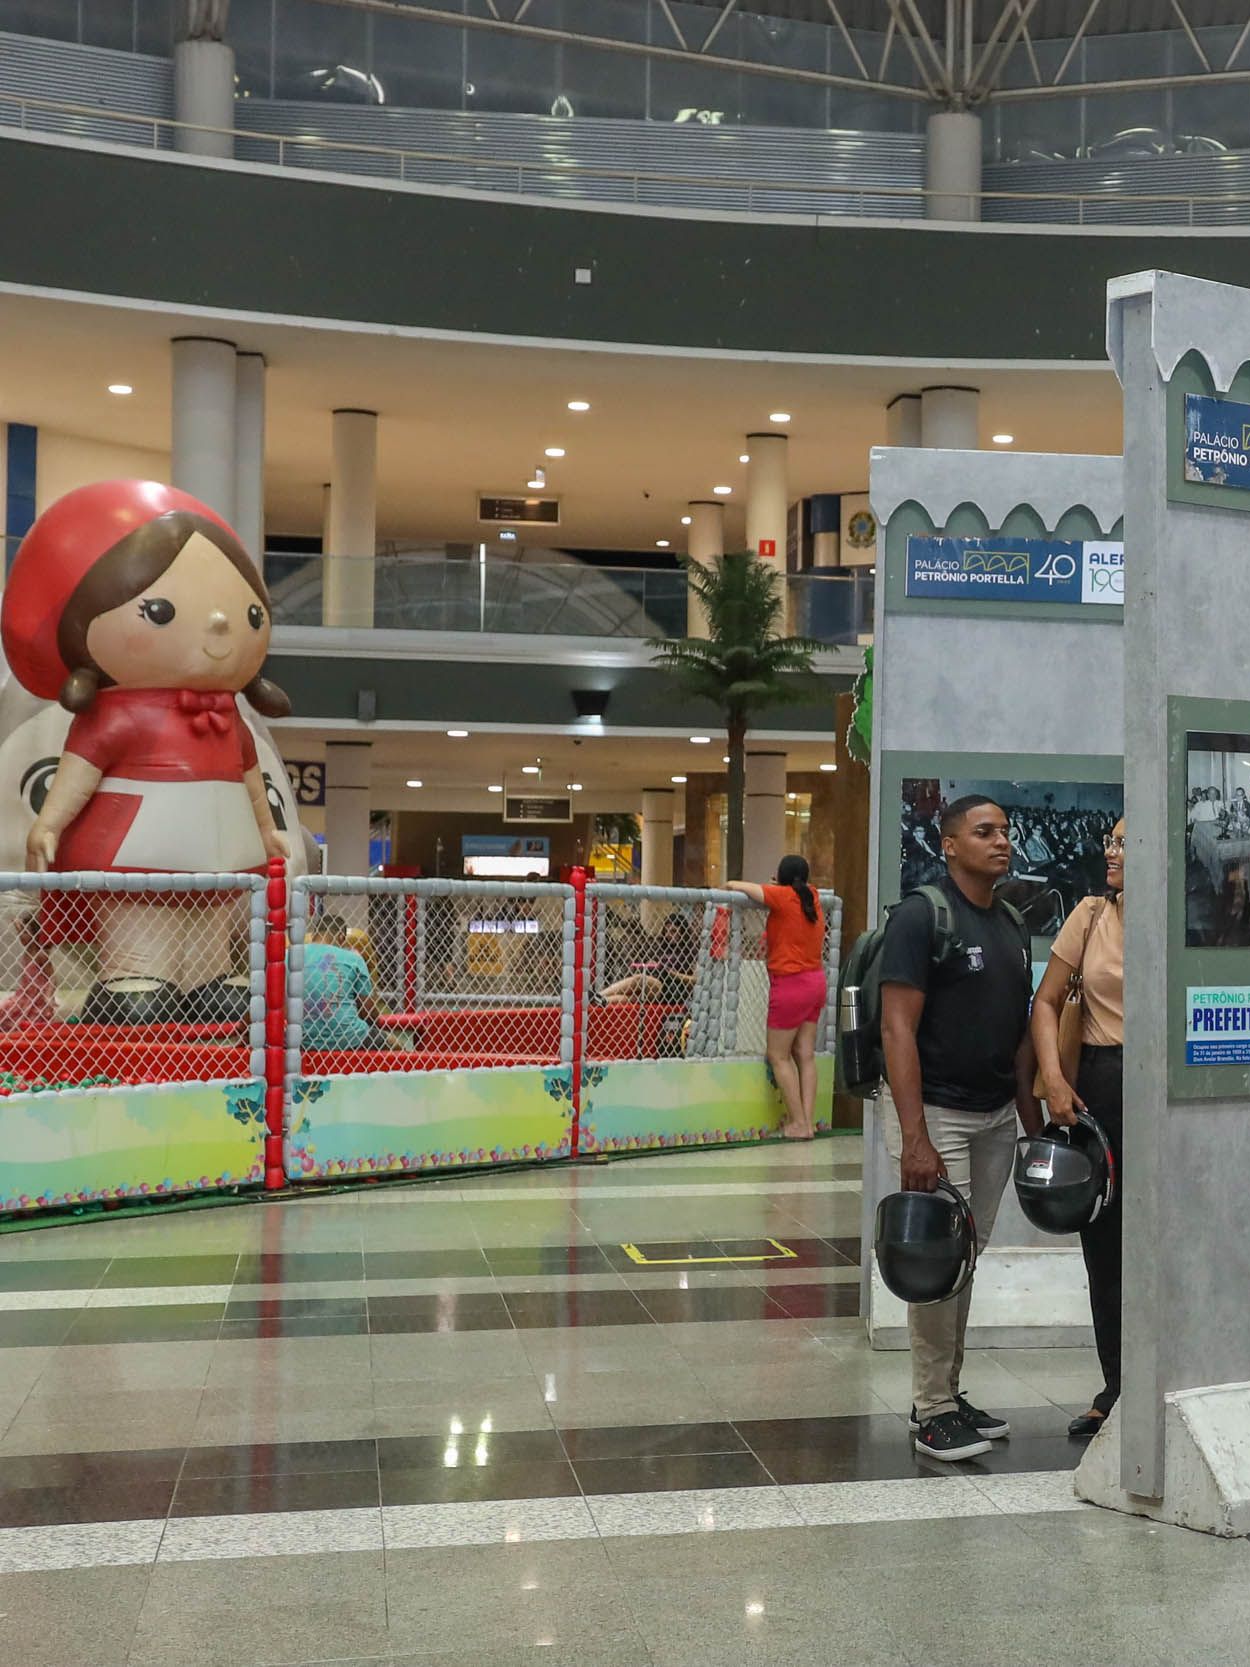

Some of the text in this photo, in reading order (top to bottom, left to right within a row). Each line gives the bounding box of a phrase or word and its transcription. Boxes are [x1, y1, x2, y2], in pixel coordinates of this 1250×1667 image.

[1193, 431, 1239, 450] PALÁCIO
[1193, 447, 1248, 467] PETRÔNIO
[915, 557, 960, 570] PALÁCIO
[1034, 554, 1076, 586] 40
[914, 570, 1024, 585] PETRÔNIO PORTELLA
[1193, 991, 1245, 1004] PETRÔNIO
